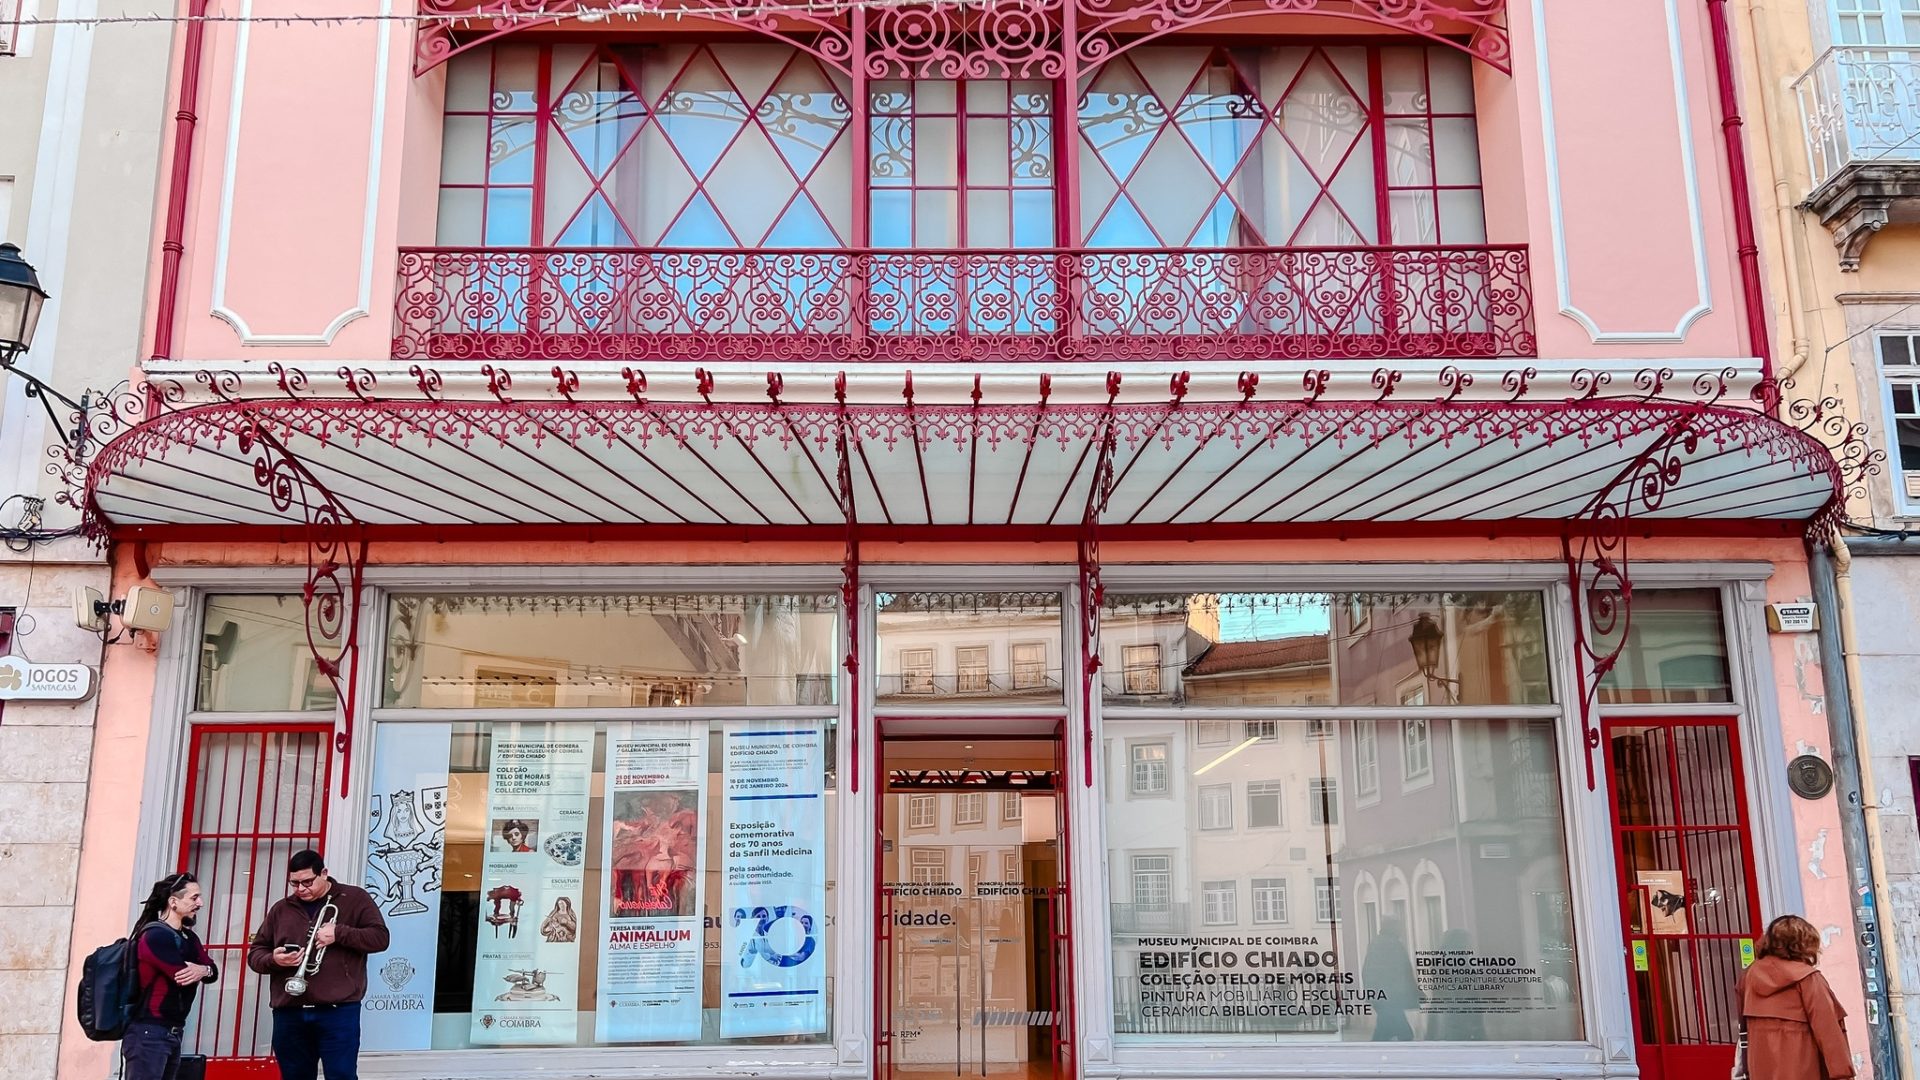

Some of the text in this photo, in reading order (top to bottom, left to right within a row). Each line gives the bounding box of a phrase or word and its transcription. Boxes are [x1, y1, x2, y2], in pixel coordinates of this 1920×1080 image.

[26, 669, 78, 687] JOGOS
[730, 821, 775, 830] Exposição
[730, 830, 794, 839] comemorativa
[772, 848, 812, 856] Medicina
[977, 886, 1019, 895] EDIFÍCIO
[609, 930, 691, 942] ANIMALIUM
[1138, 938, 1178, 946] MUSEU
[1181, 937, 1244, 946] MUNICIPAL
[1265, 937, 1318, 945] COIMBRA
[1140, 946, 1337, 968] EDIFÍCIO CHIADO
[1416, 955, 1516, 967] EDIFÍCIO CHIADO
[1140, 970, 1353, 989] COLEÇÃO TELO DE MORAIS
[1141, 987, 1387, 1002] PINTURA MOBILIÁRIO ESCULTURA
[365, 999, 425, 1010] COIMBRA
[1223, 1005, 1307, 1016] BIBLIOTECA
[1311, 1005, 1331, 1016] DE
[1334, 1004, 1372, 1016] ARTE
[500, 1020, 541, 1028] COIMBRA
